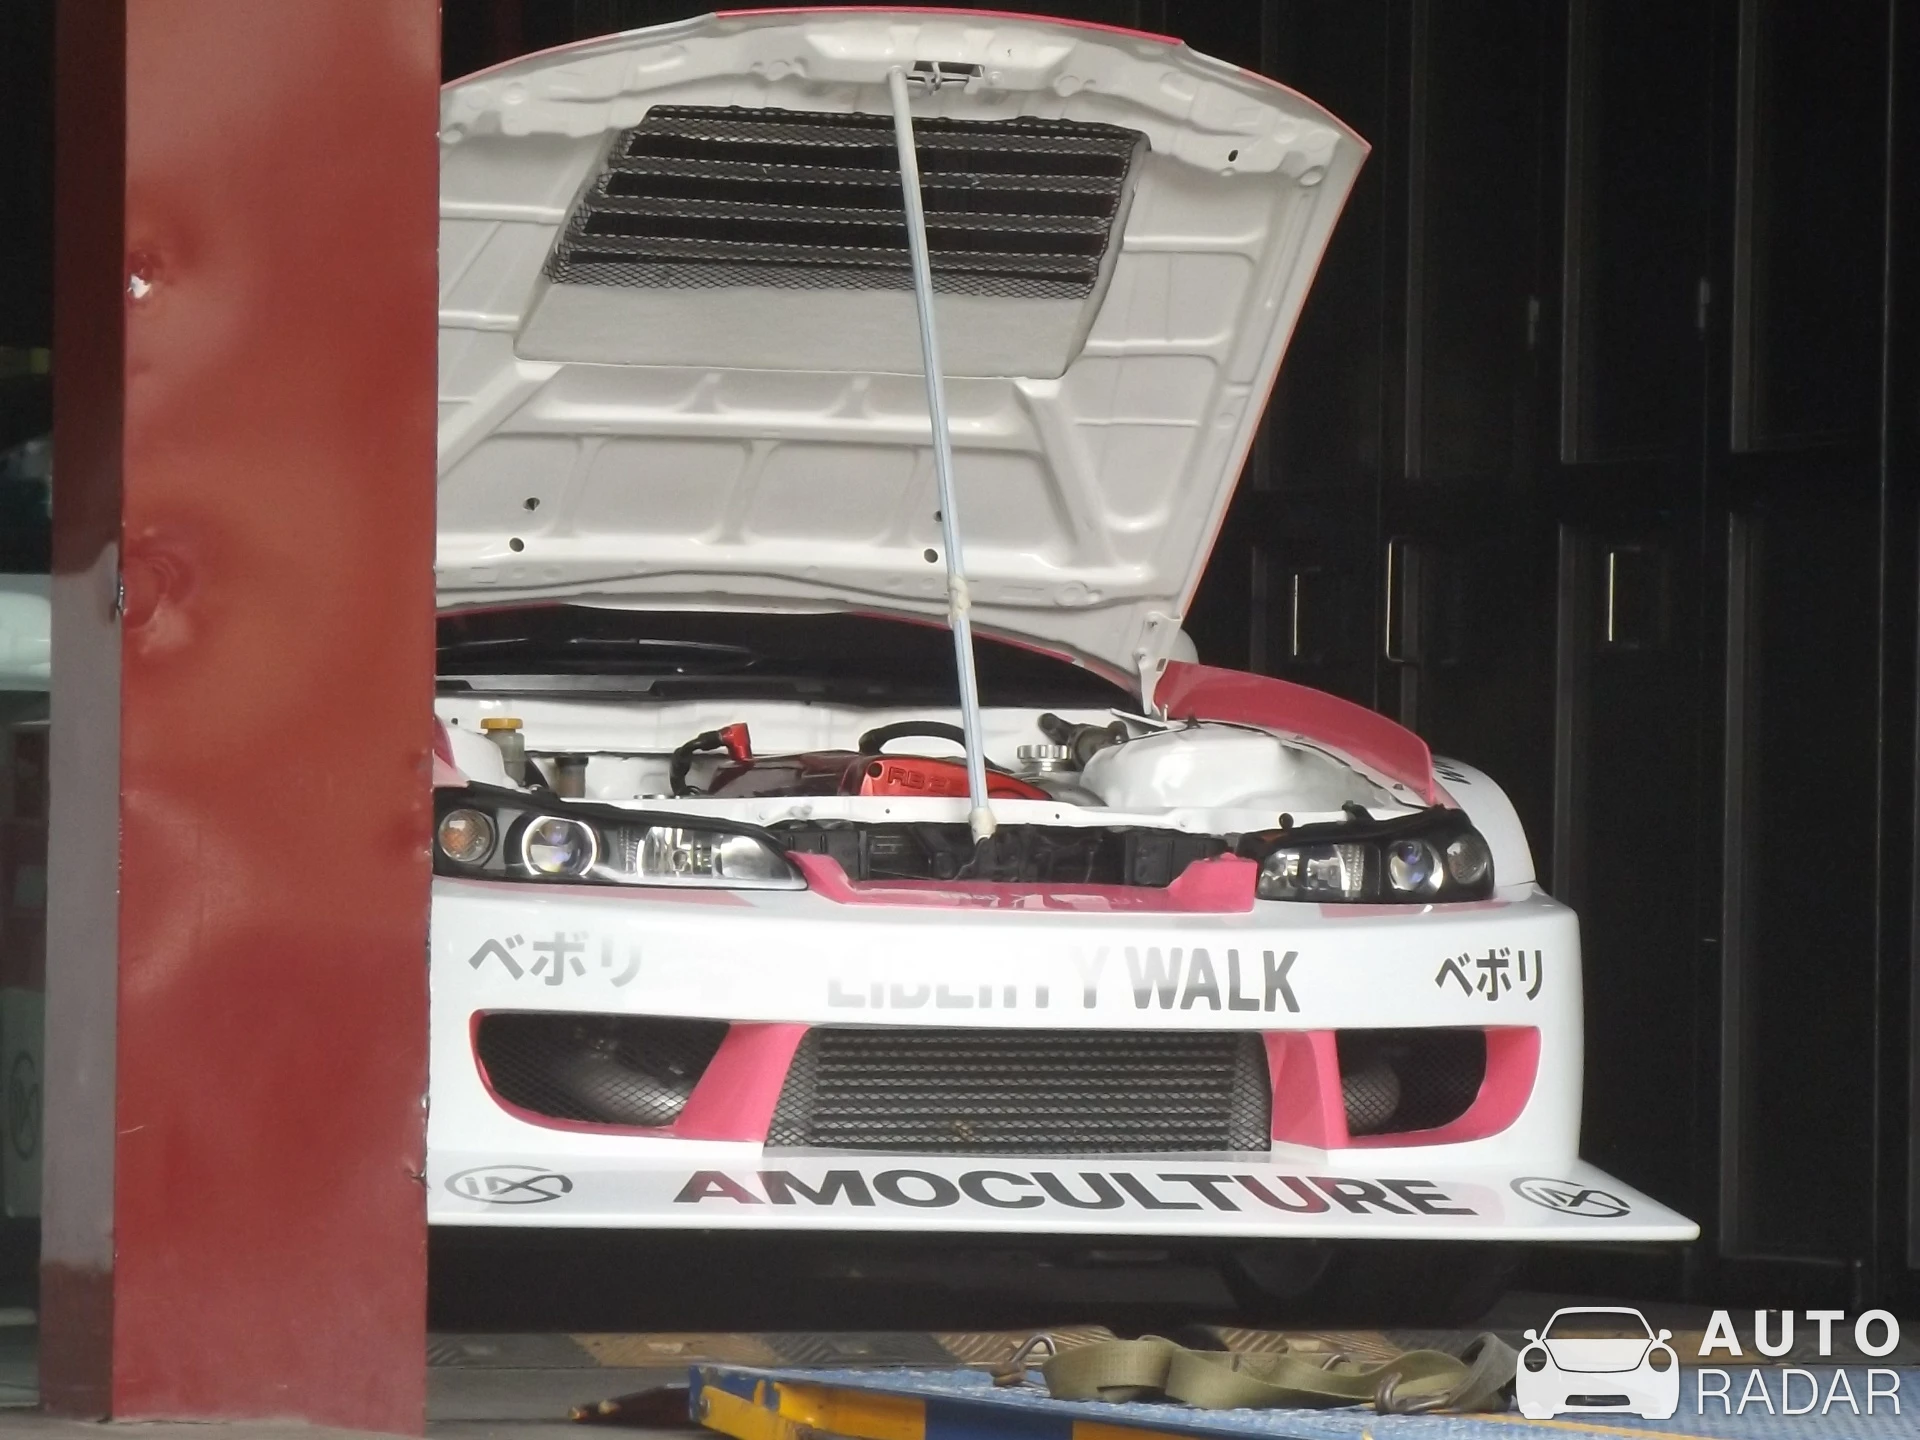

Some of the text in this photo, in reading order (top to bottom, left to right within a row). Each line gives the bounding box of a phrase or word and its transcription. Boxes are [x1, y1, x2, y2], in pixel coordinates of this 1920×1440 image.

[468, 931, 641, 988] ベボリ
[1124, 946, 1300, 1013] WALK
[1434, 946, 1543, 1002] ベボリ
[673, 1168, 1479, 1215] AMOCULTURE
